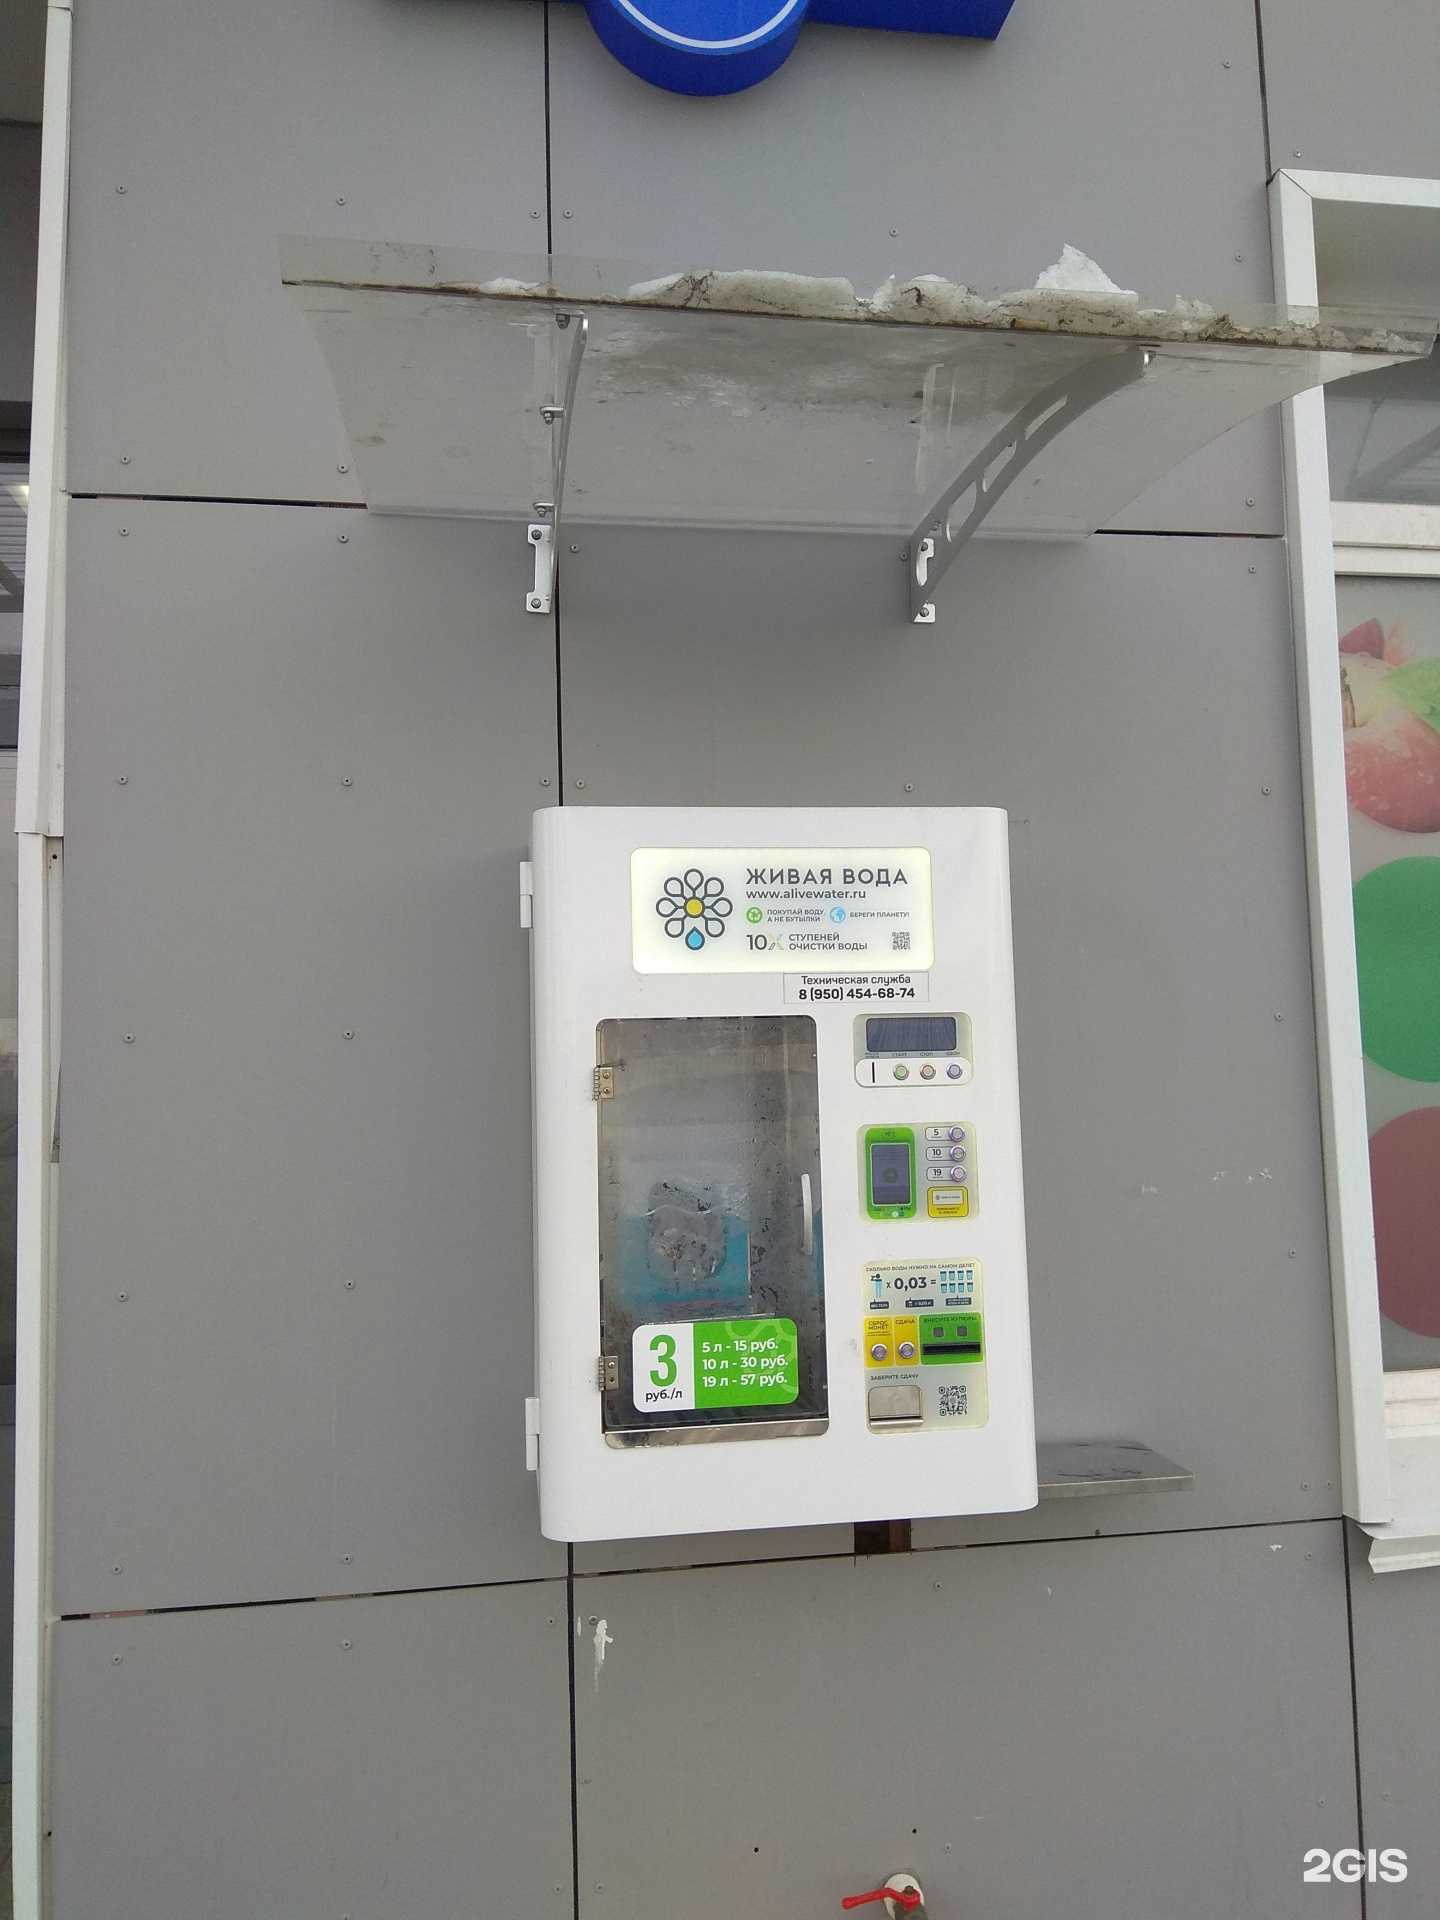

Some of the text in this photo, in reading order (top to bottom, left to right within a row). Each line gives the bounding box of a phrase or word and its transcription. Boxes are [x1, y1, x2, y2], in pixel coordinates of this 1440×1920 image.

[746, 868, 908, 887] ЖИВАЯ ВОДА
[746, 888, 866, 899] www.alivewater.ru
[767, 908, 803, 916] ПОКУПАЙ
[746, 934, 768, 951] 10
[788, 932, 840, 942] СТУПЕНЕЙ
[788, 942, 868, 951] ОЧИСТКИ ВОДЫ
[801, 974, 911, 986] Техническая служба
[799, 987, 915, 1001] 8 (950) 454-68-74
[933, 1128, 940, 1136] 5
[932, 1148, 942, 1156] 10
[932, 1168, 942, 1176] 19
[894, 1276, 928, 1291] 0,03
[702, 1341, 711, 1353] 5
[713, 1343, 723, 1352] л
[733, 1340, 748, 1351] 15
[751, 1338, 779, 1352] руб.
[649, 1335, 677, 1387] 3
[702, 1358, 717, 1370] 10
[720, 1360, 729, 1369] л
[740, 1356, 757, 1368] 30
[760, 1354, 788, 1370] руб.
[702, 1376, 717, 1388] 19
[719, 1377, 729, 1387] л
[740, 1373, 756, 1385] 57
[760, 1371, 788, 1388] руб.
[645, 1388, 683, 1403] руб./л
